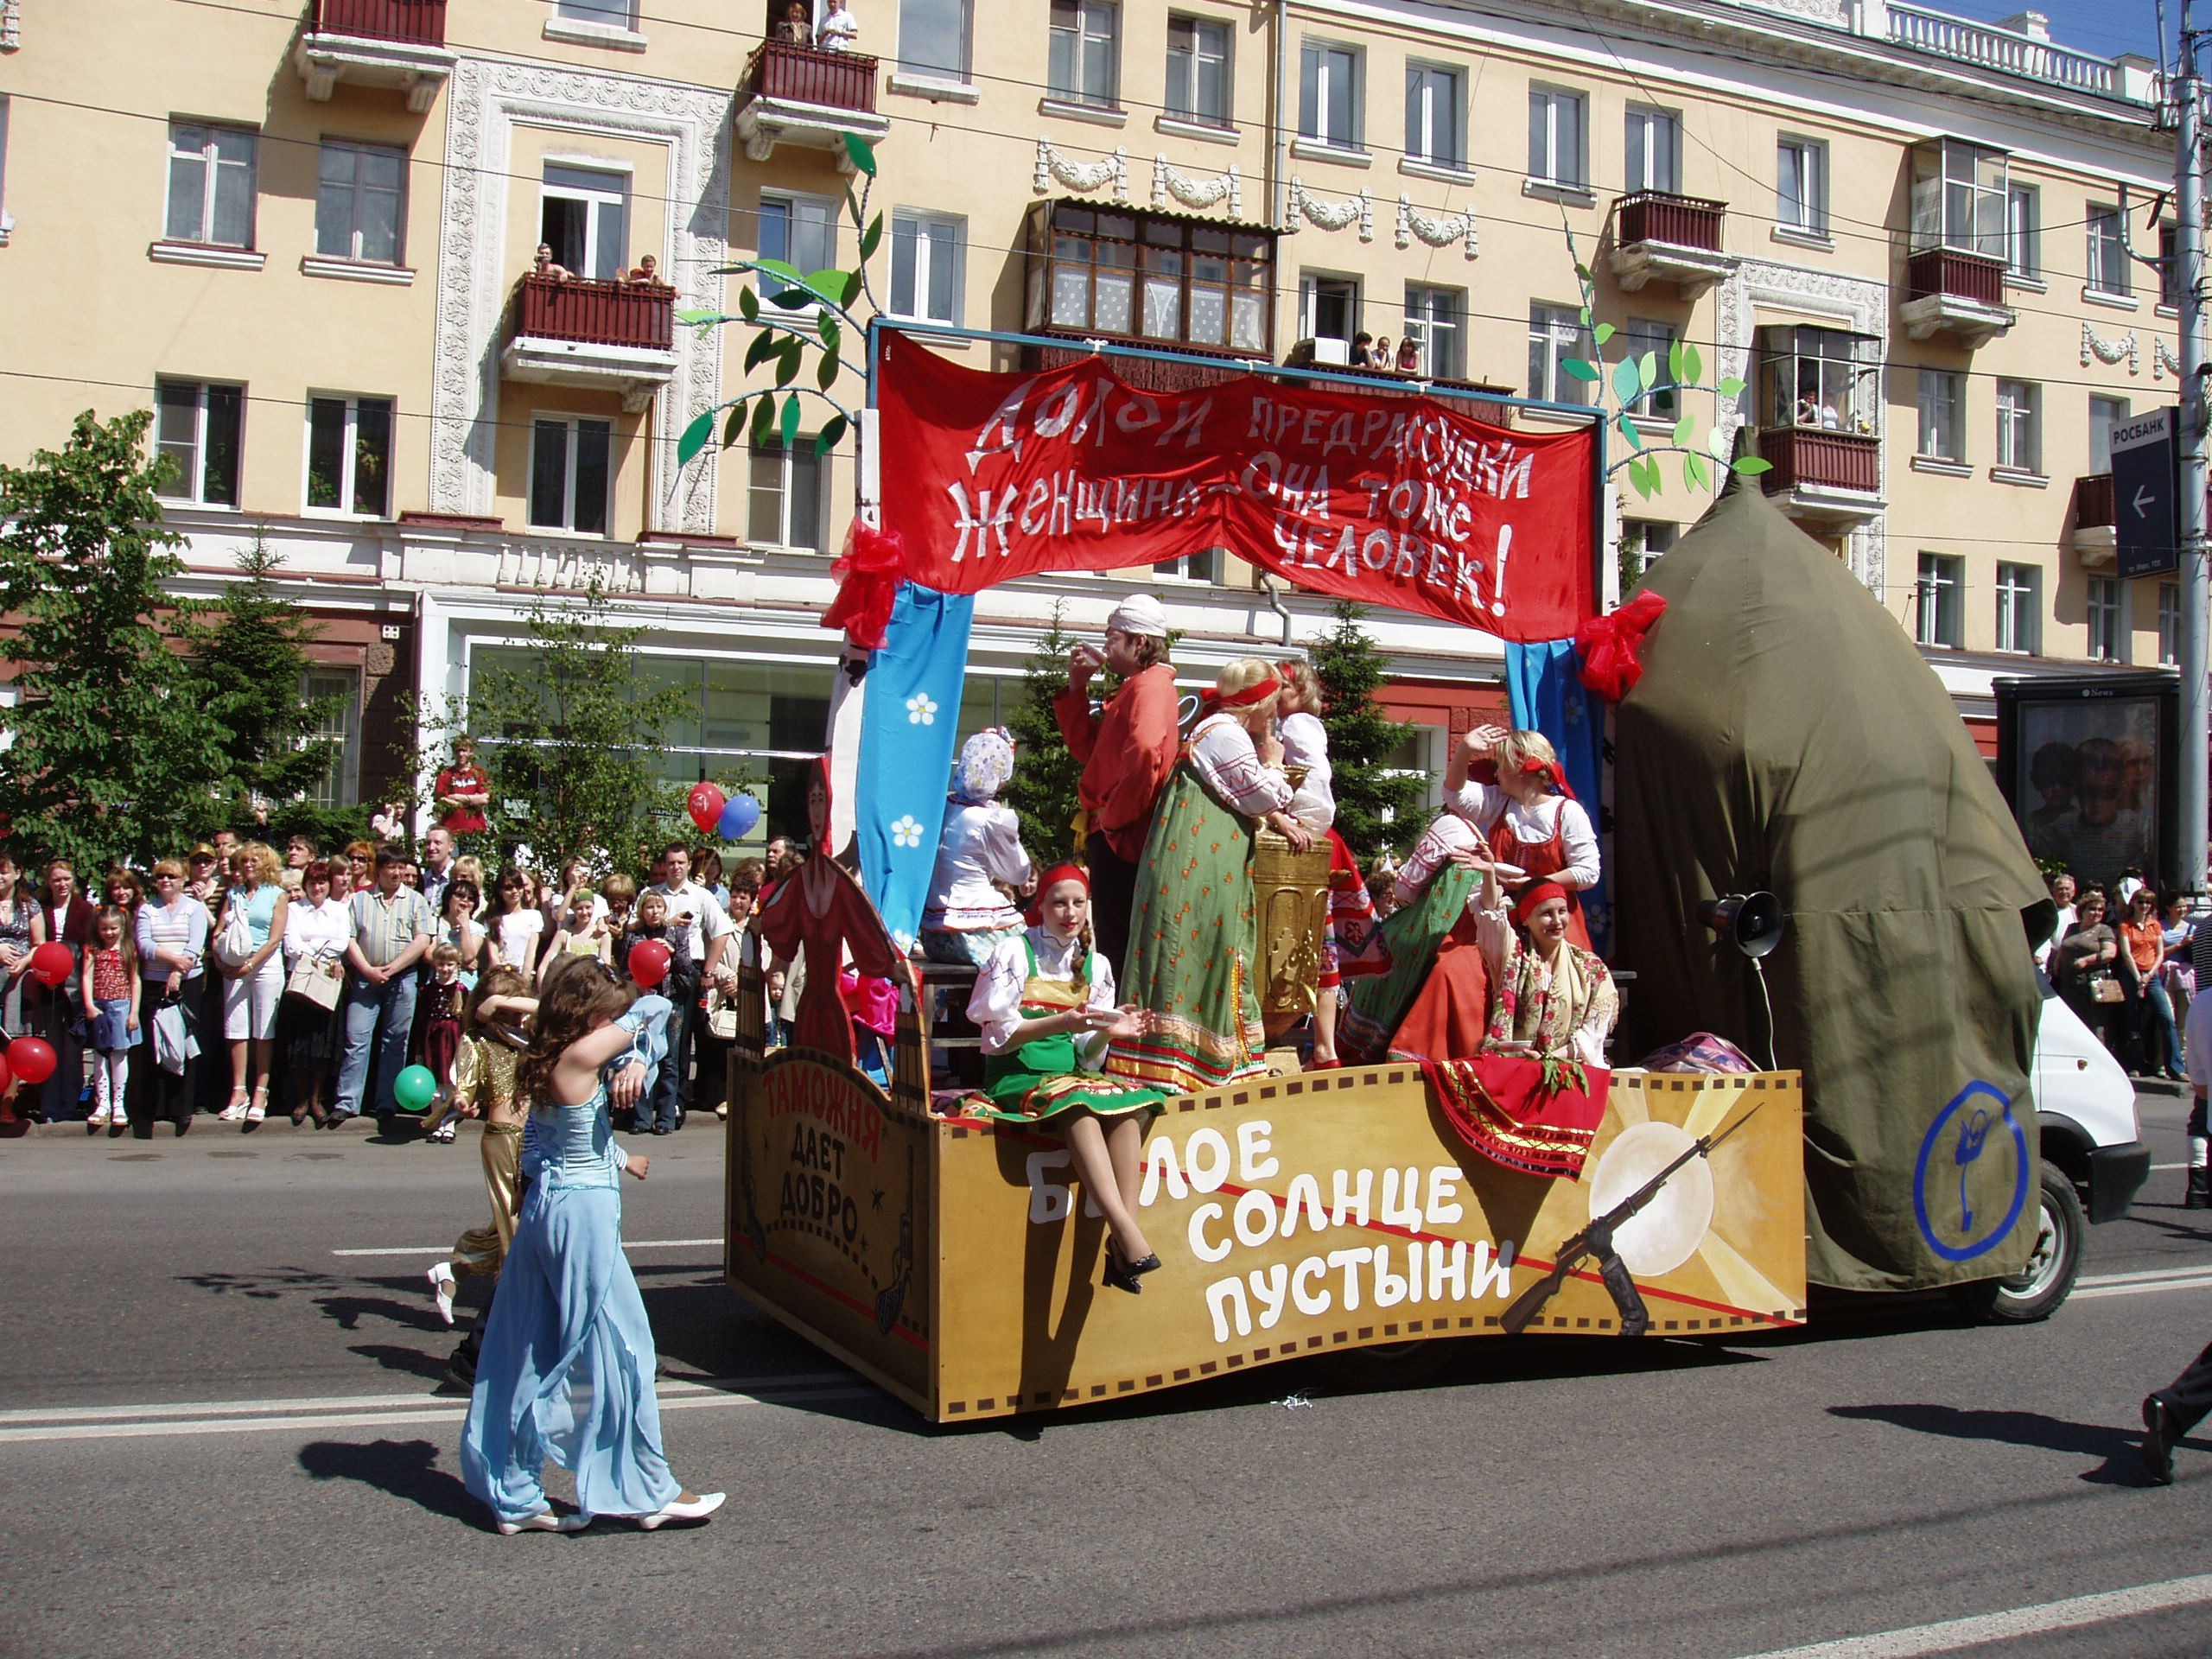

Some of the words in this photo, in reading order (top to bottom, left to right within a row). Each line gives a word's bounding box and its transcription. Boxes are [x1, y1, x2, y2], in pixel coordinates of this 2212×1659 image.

[1247, 397, 1535, 500] ПРЕДРАССУДКИ
[2113, 417, 2164, 444] РОСБАНК
[1240, 450, 1331, 520] ОНА
[761, 1065, 882, 1163] ТАМОЖНЯ
[791, 1122, 846, 1181] ДАЕТ
[779, 1171, 859, 1243] ДОБРО
[1026, 1119, 1280, 1224] БЛОЕ
[1187, 1166, 1463, 1264] СОЛНЦЕ
[1205, 1239, 1514, 1343] ПУСТЫНИ
